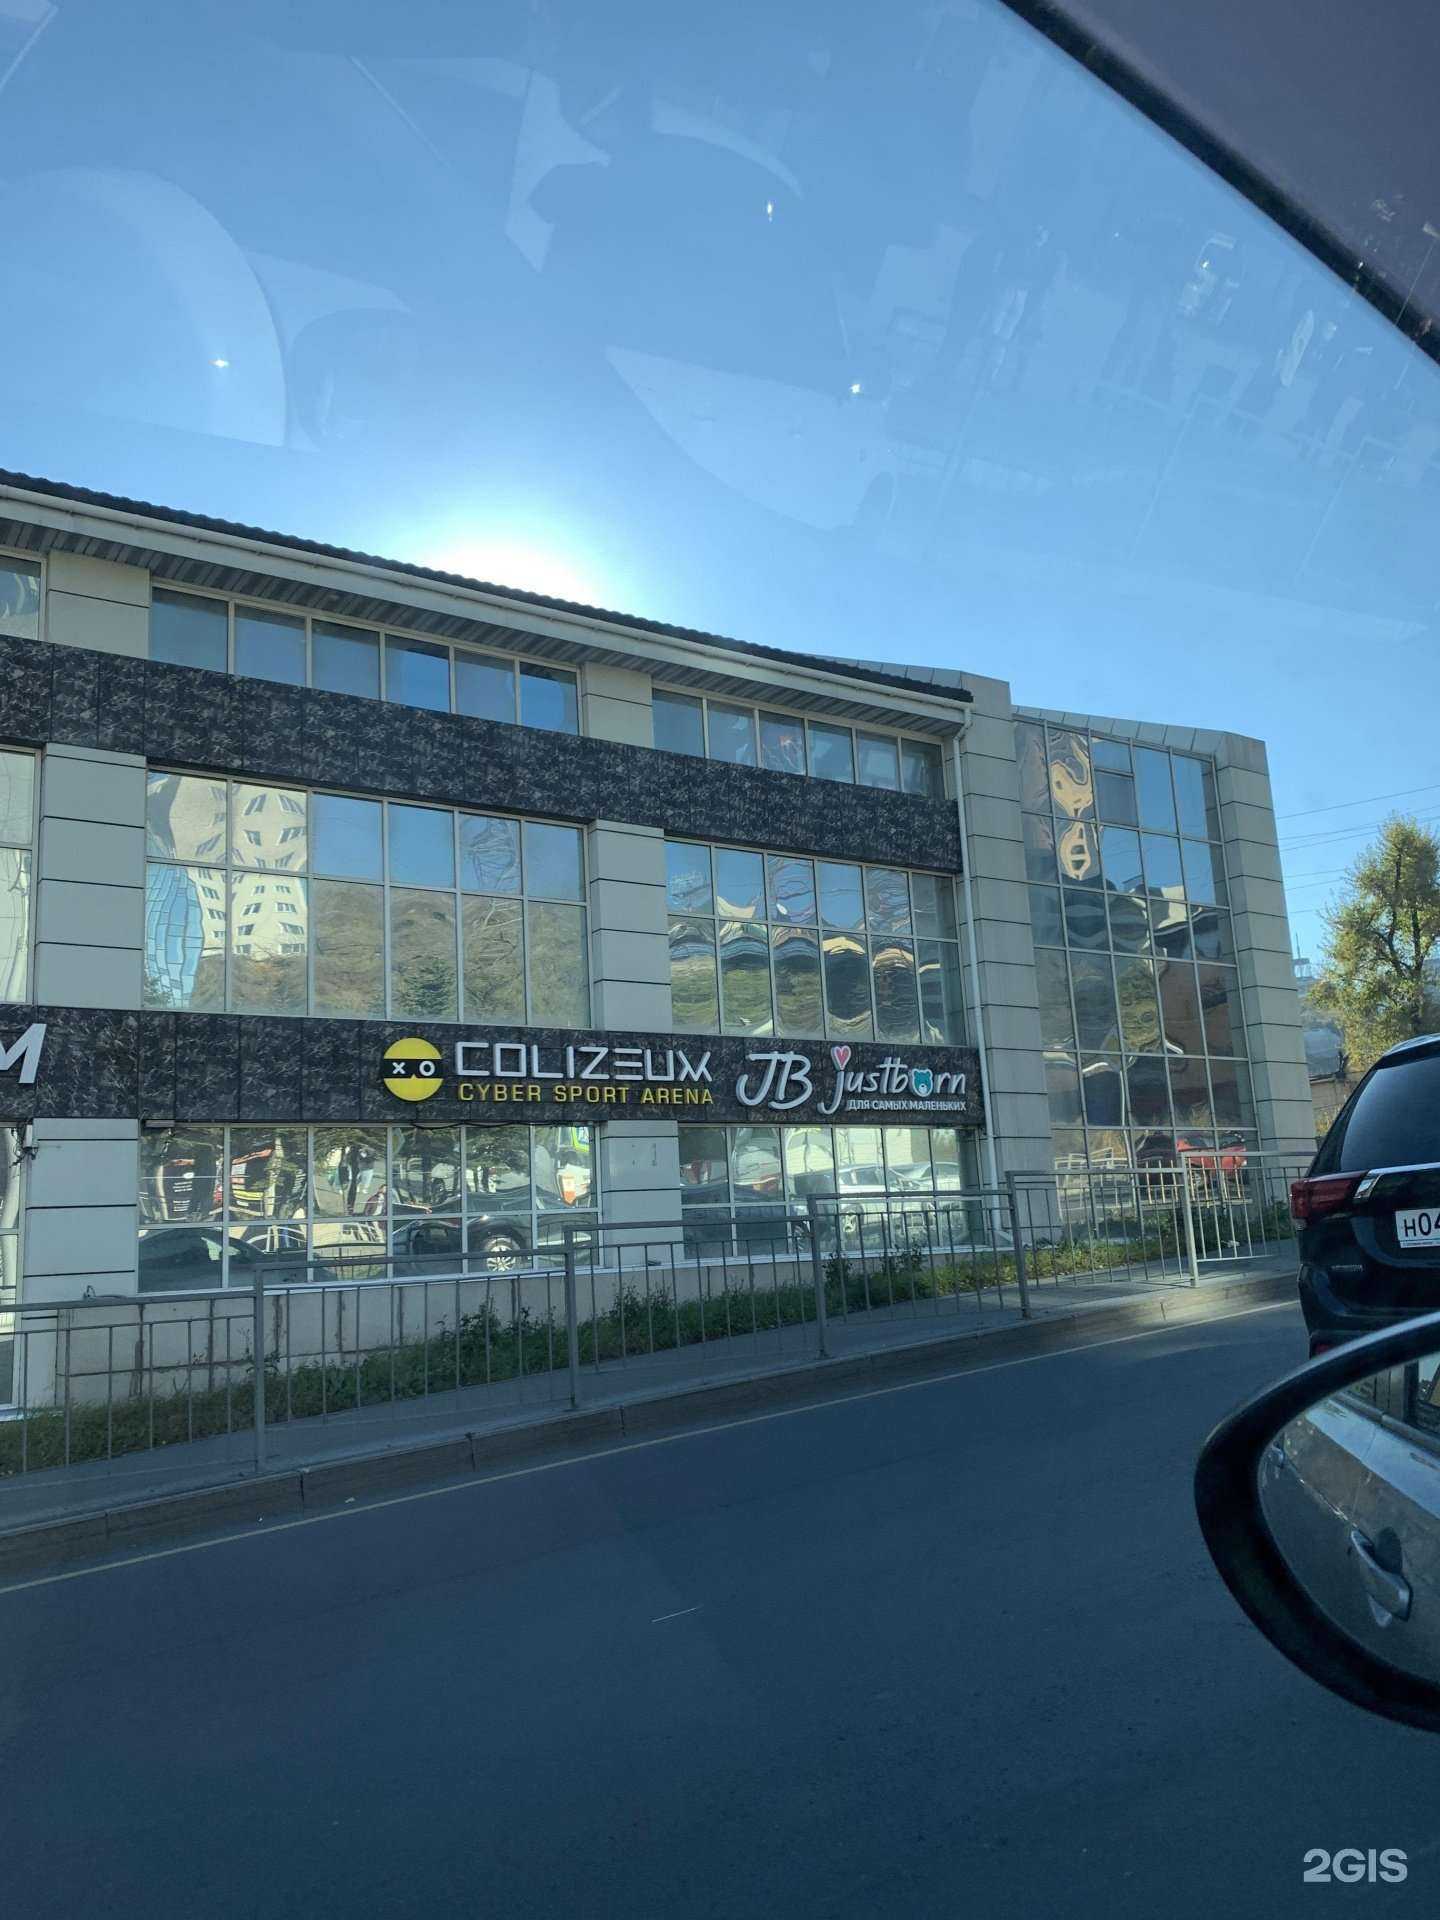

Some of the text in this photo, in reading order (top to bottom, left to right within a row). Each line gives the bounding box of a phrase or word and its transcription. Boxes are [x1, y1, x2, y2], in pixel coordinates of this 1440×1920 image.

[736, 1051, 813, 1110] JB
[458, 1083, 714, 1105] CYBER SPORT ARENA
[848, 1100, 966, 1111] ДЛЯ САМЫХ МАЛЕНЬКИХ
